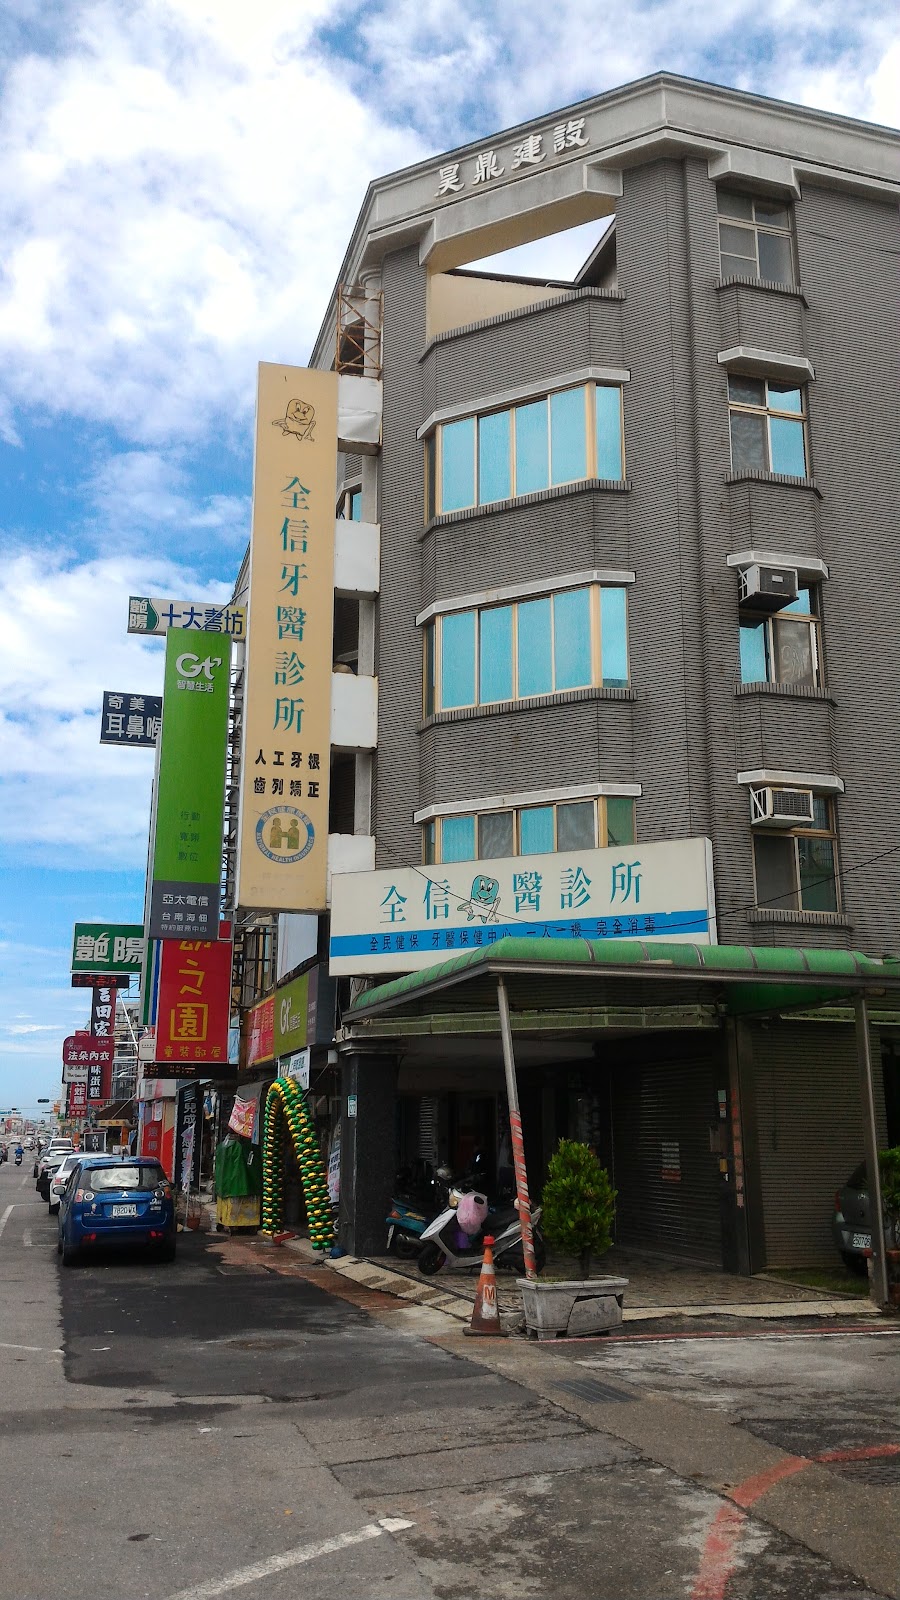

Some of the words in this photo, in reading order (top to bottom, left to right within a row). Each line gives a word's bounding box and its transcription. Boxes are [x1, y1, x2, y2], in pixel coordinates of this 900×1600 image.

[434, 117, 590, 197] 昊鼎建設
[161, 603, 244, 635] 十大書坊
[272, 476, 311, 734] 全信牙醫診所
[177, 680, 214, 693] 智慧生活
[255, 749, 320, 770] 人工牙根
[162, 893, 209, 907] 亞太電信
[369, 934, 419, 951] 全民健保
[597, 916, 656, 936] 完全消毒
